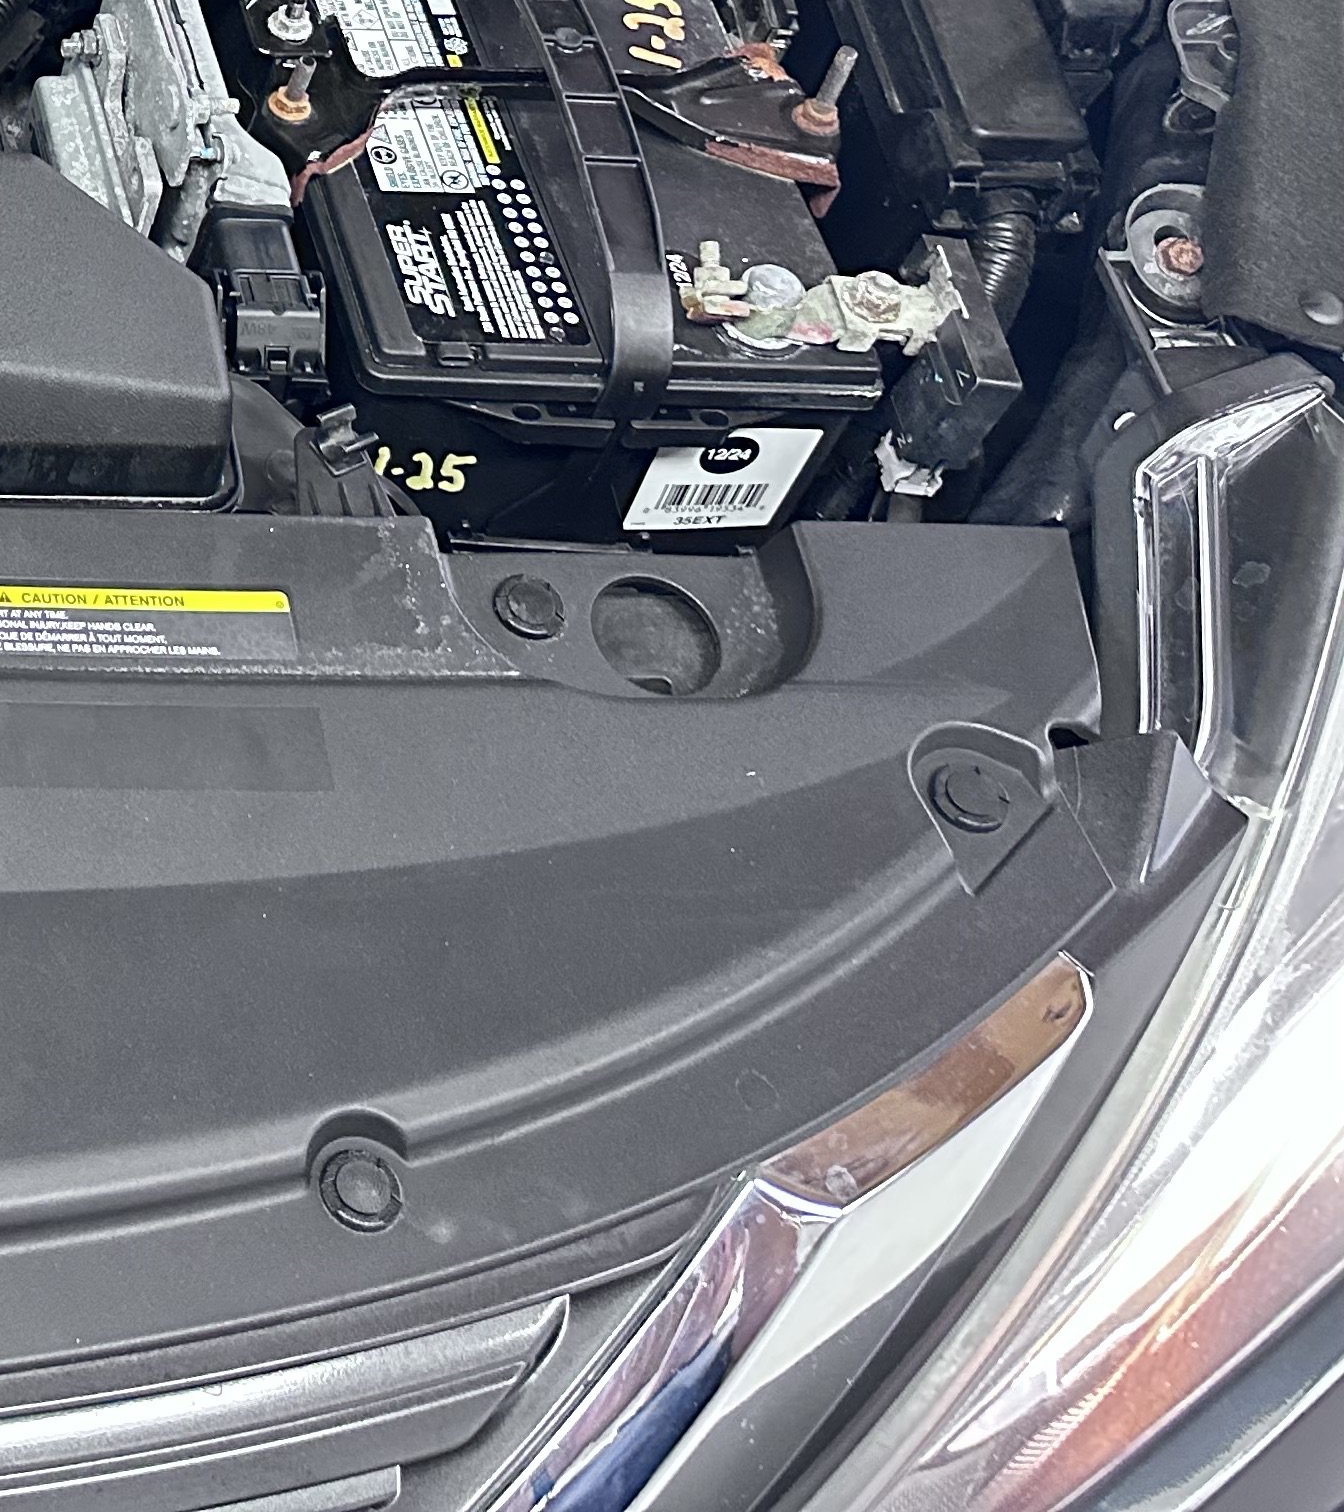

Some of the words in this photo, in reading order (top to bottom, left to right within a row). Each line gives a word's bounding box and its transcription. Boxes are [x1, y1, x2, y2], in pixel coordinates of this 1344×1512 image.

[385, 224, 423, 305] SUPER
[403, 223, 456, 318] START
[707, 447, 753, 462] 12/24
[672, 514, 727, 526] 35EXT
[21, 592, 87, 605] CAUTION
[104, 594, 185, 607] ATTENTION
